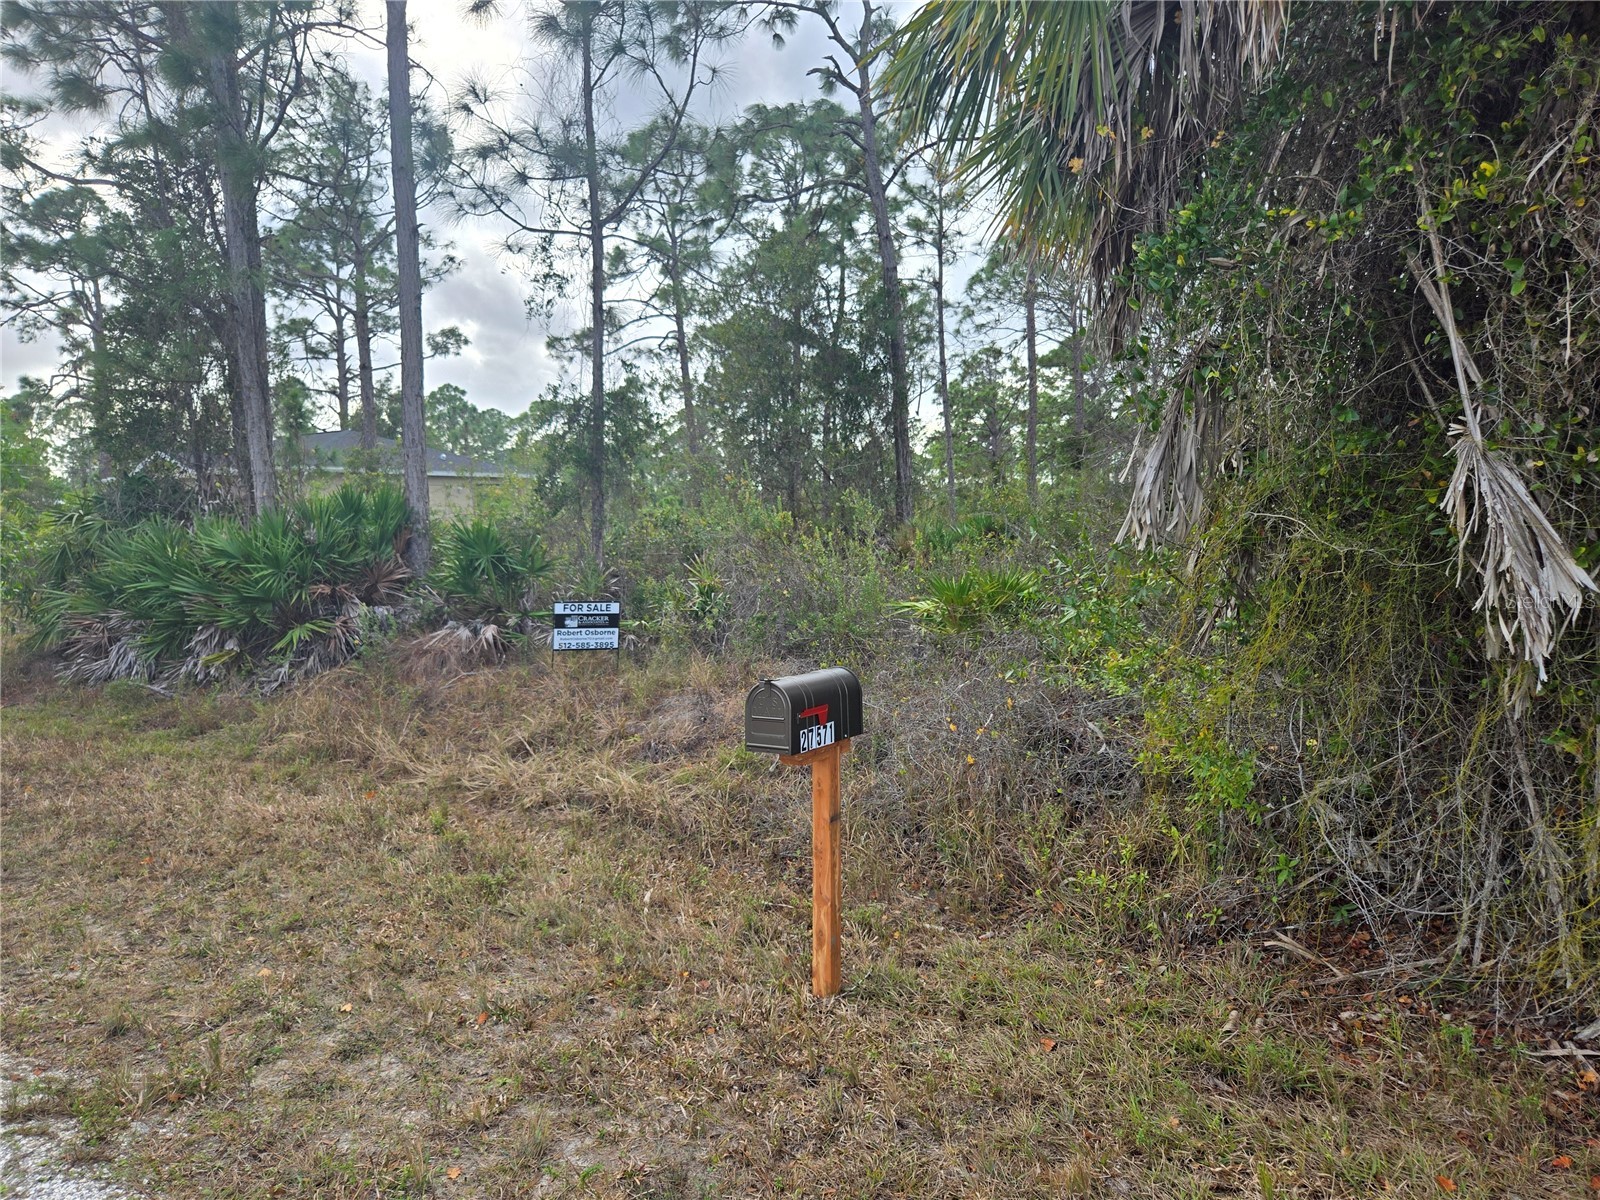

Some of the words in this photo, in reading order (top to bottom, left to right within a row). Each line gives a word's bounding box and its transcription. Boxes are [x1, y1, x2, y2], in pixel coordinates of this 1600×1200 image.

[563, 603, 584, 612] FOR
[586, 603, 612, 612] SALE
[558, 641, 615, 649] 512-585-3895
[801, 723, 833, 751] 27571
